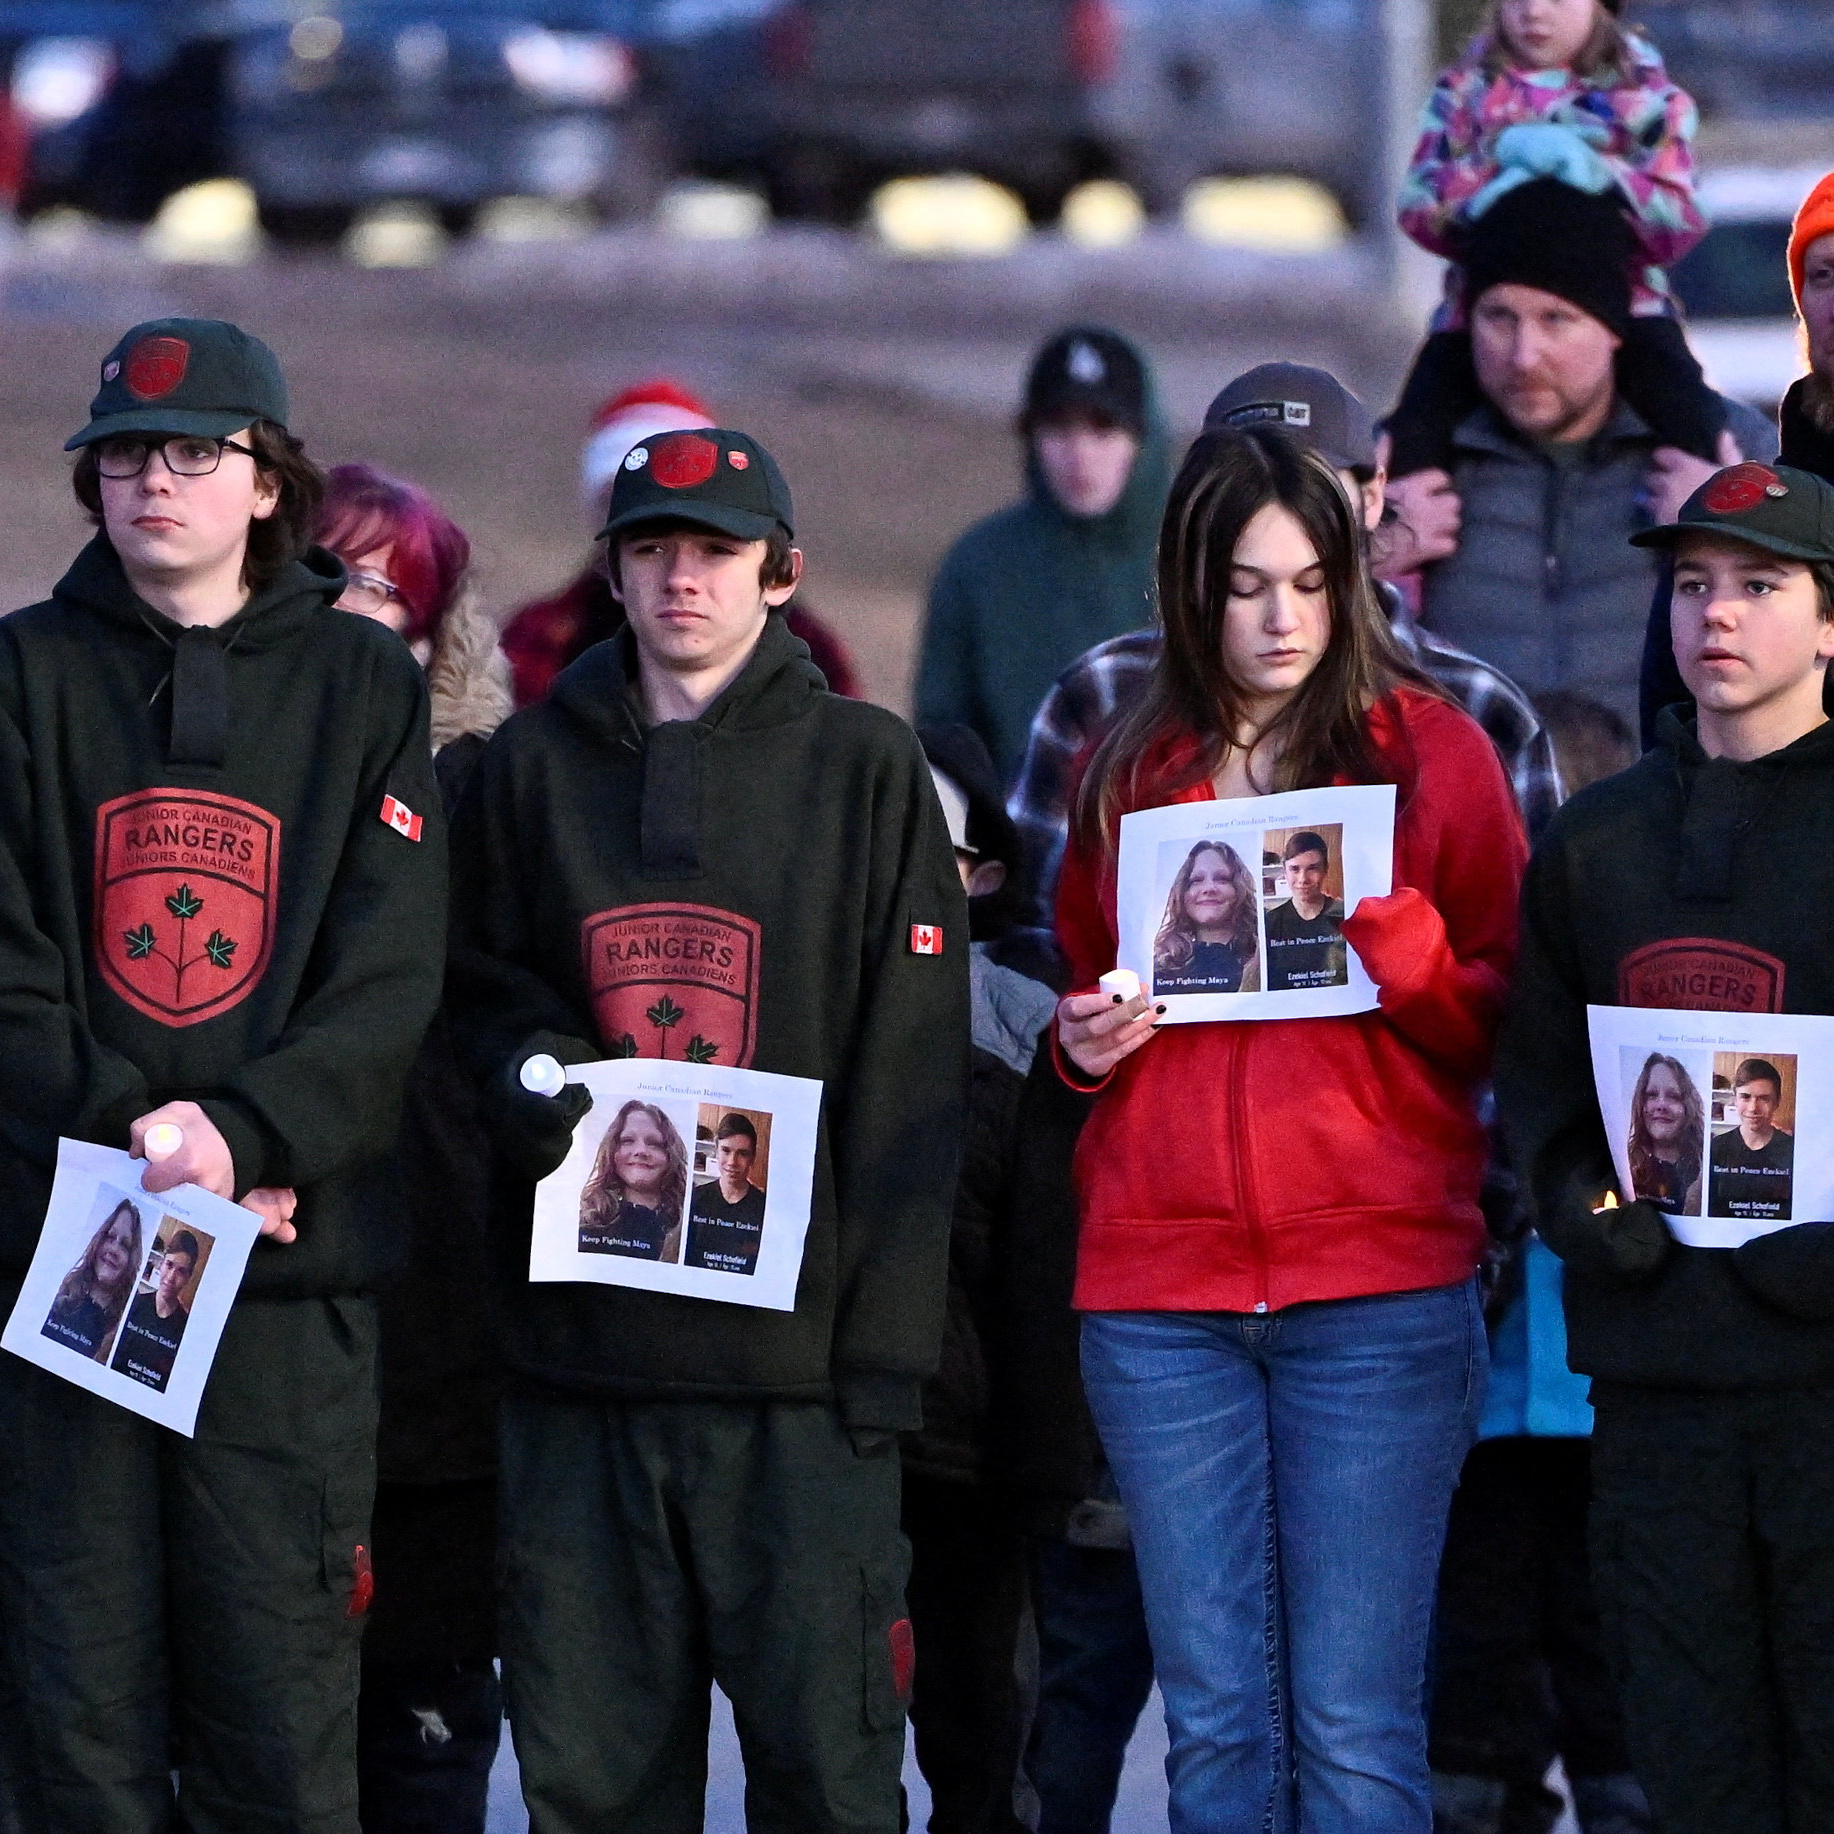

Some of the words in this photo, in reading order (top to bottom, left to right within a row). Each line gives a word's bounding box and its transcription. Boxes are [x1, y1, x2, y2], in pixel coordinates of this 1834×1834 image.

[130, 808, 179, 824] JUNIOR
[183, 810, 252, 835] CANADIAN
[125, 824, 254, 862] RANGERS
[121, 852, 177, 869] JUNIORS
[182, 852, 255, 879] CANADIENS
[612, 923, 659, 937] JUNIOR
[664, 923, 731, 943] CANADIAN
[606, 937, 734, 968] RANGERS
[601, 964, 657, 981] JUNIORS
[662, 964, 736, 985] CANADIENS
[1156, 978, 1174, 987] Keep
[1176, 976, 1207, 987] Fighting
[1208, 976, 1229, 986] Maya
[1639, 974, 1757, 1006] RANGERS
[665, 1085, 702, 1095] Canadian
[693, 1215, 707, 1224] Rest
[708, 1217, 715, 1225] in
[736, 1221, 759, 1231] Ezekiel
[581, 1235, 601, 1245] Keep
[602, 1236, 631, 1249] Fighting
[632, 1240, 651, 1250] Maya
